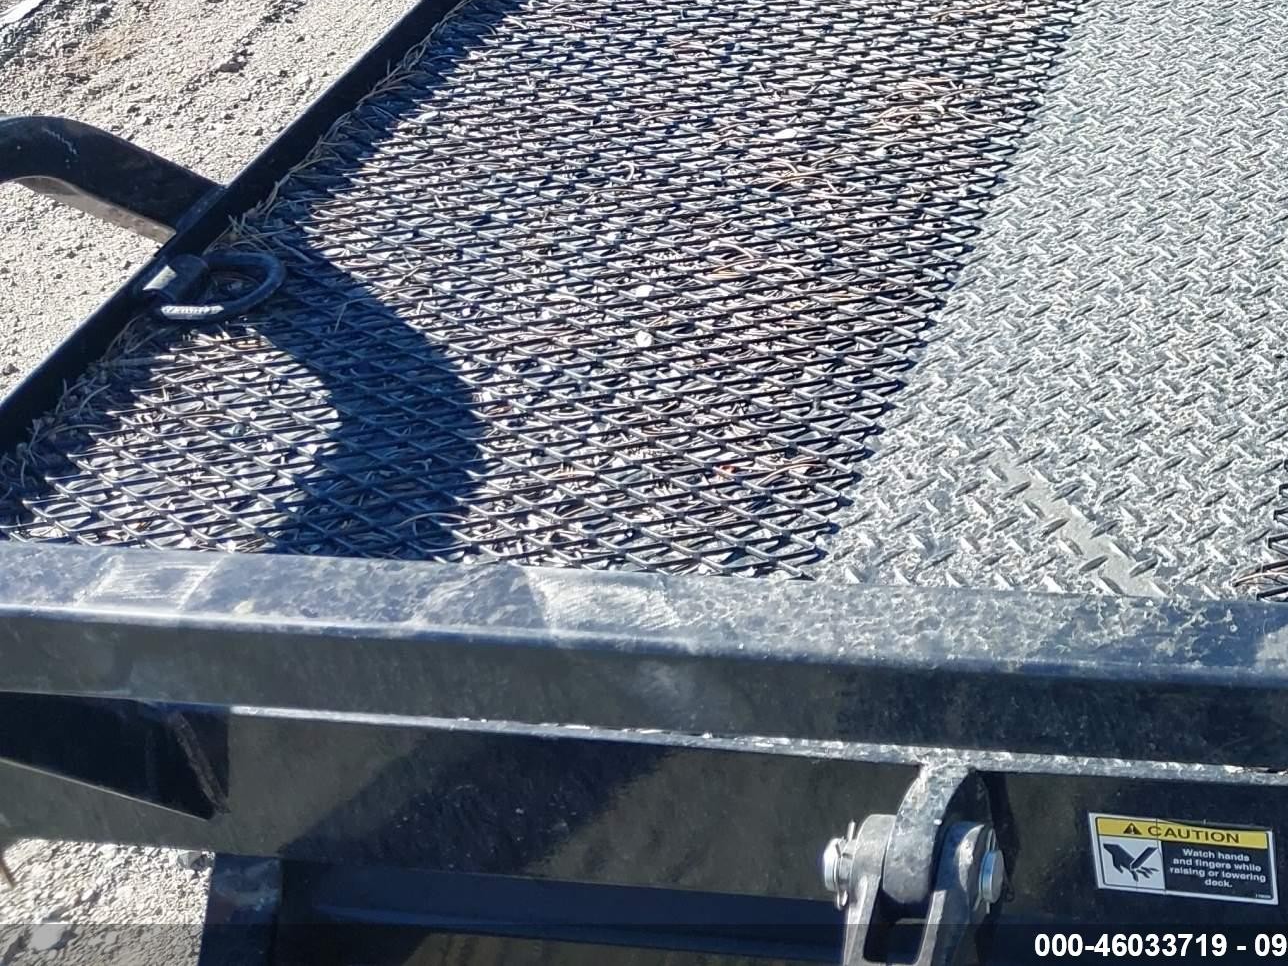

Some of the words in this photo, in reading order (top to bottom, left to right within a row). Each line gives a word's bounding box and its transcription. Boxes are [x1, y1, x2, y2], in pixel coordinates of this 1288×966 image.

[1147, 826, 1240, 844] CAUTION
[1182, 848, 1216, 859] Watch
[1218, 851, 1250, 862] hands
[1173, 857, 1194, 867] and
[1195, 859, 1231, 871] fingers
[1233, 862, 1262, 872] while
[1170, 866, 1205, 877] raising
[1221, 870, 1266, 883] lowering
